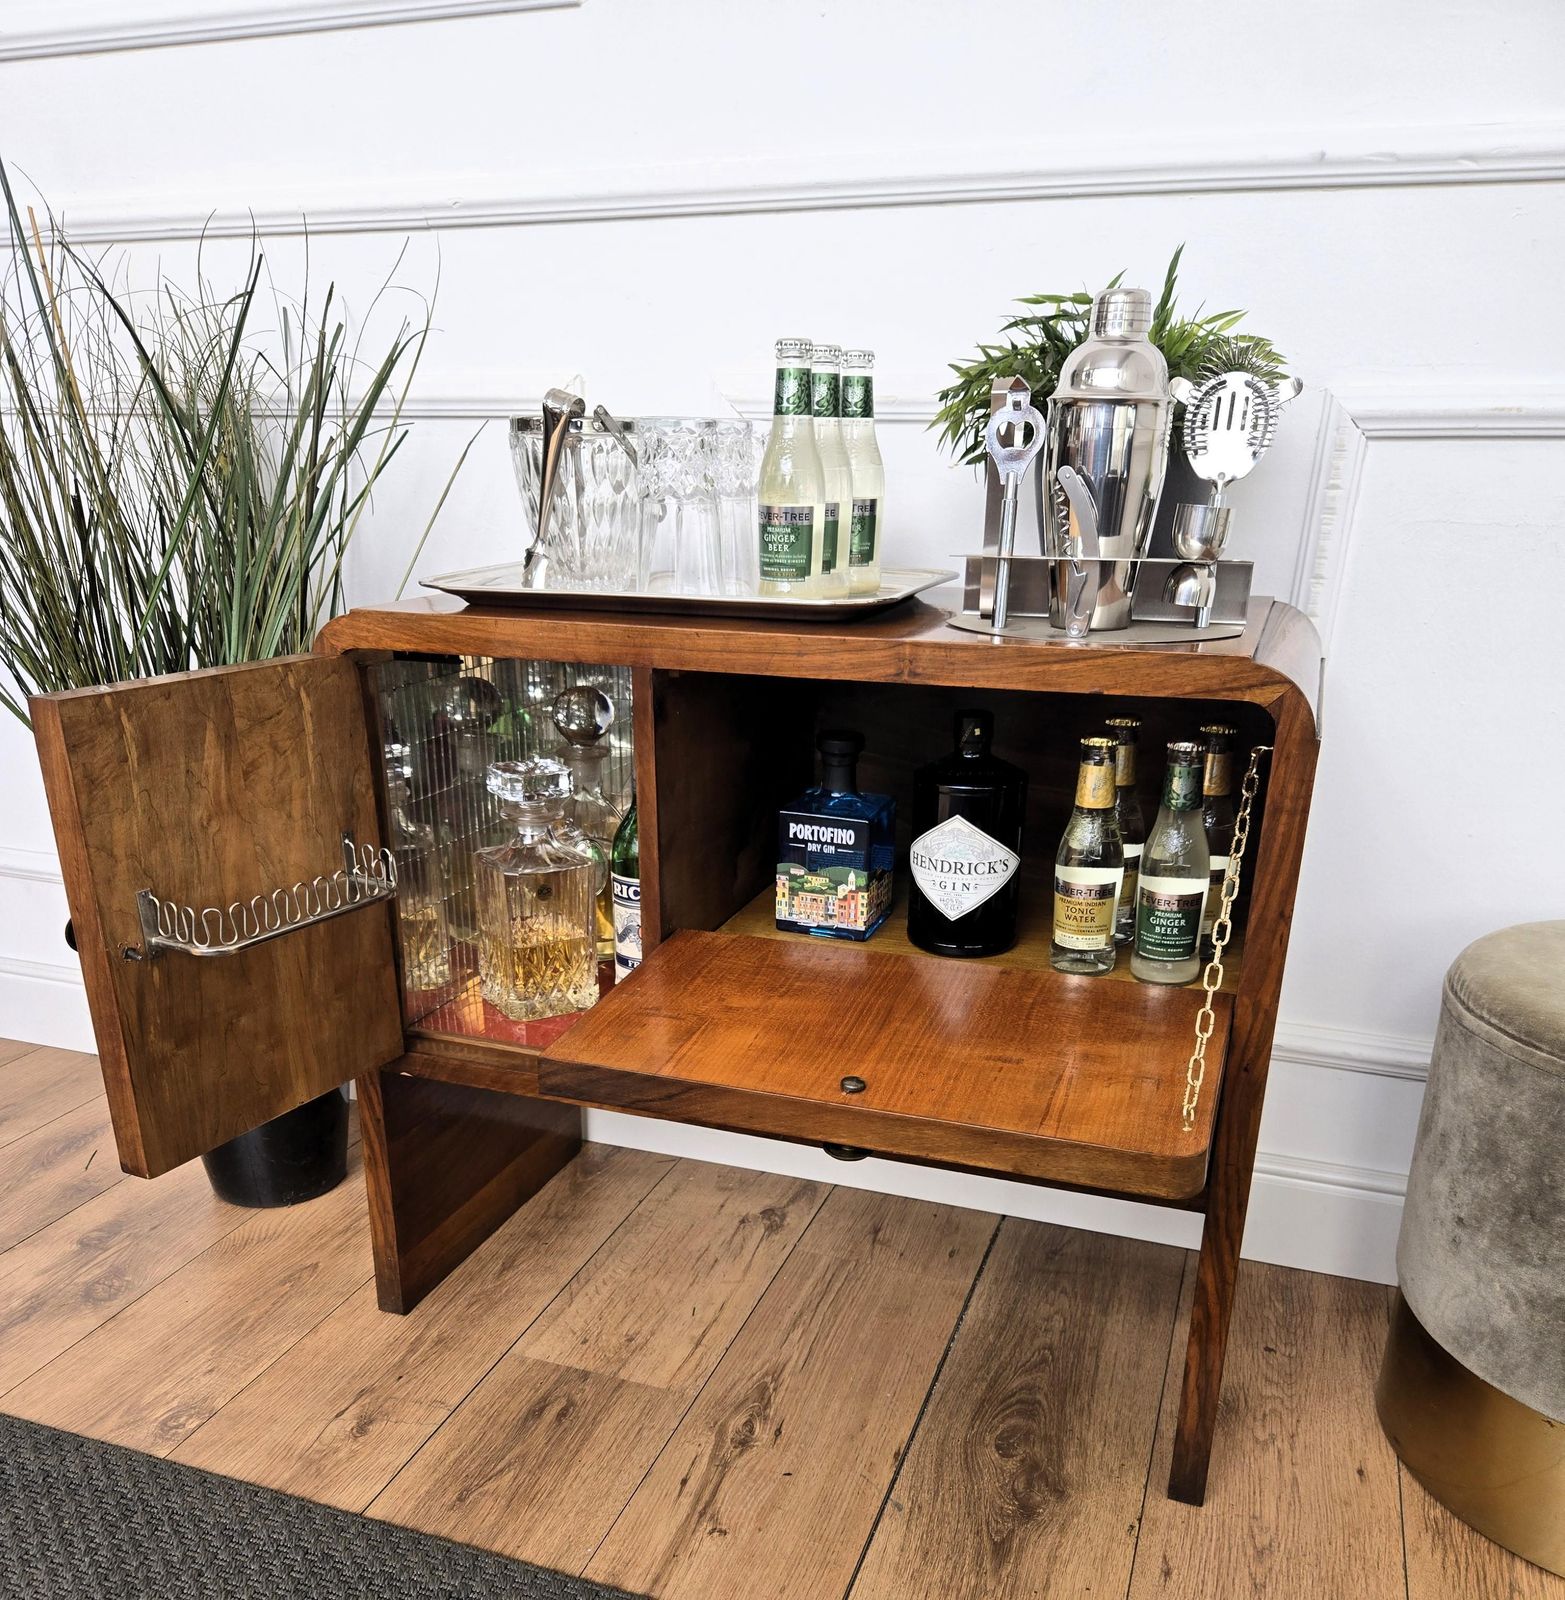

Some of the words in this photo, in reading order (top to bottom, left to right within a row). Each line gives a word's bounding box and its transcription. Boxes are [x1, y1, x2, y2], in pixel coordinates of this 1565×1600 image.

[764, 535, 796, 543] GINGER
[768, 544, 790, 552] BEER
[789, 822, 855, 846] PORTOFINO
[807, 842, 821, 852] DRY
[823, 844, 835, 854] GIN
[912, 851, 1009, 876] HENDRICK'S
[939, 880, 971, 892] GIN
[1058, 896, 1083, 906] PREMIUM
[1141, 892, 1200, 907] FEVER-TREE
[1065, 906, 1095, 915] TONIC
[1064, 914, 1096, 923] WATER
[1150, 917, 1186, 926] GINGER
[1155, 926, 1179, 934] BEER
